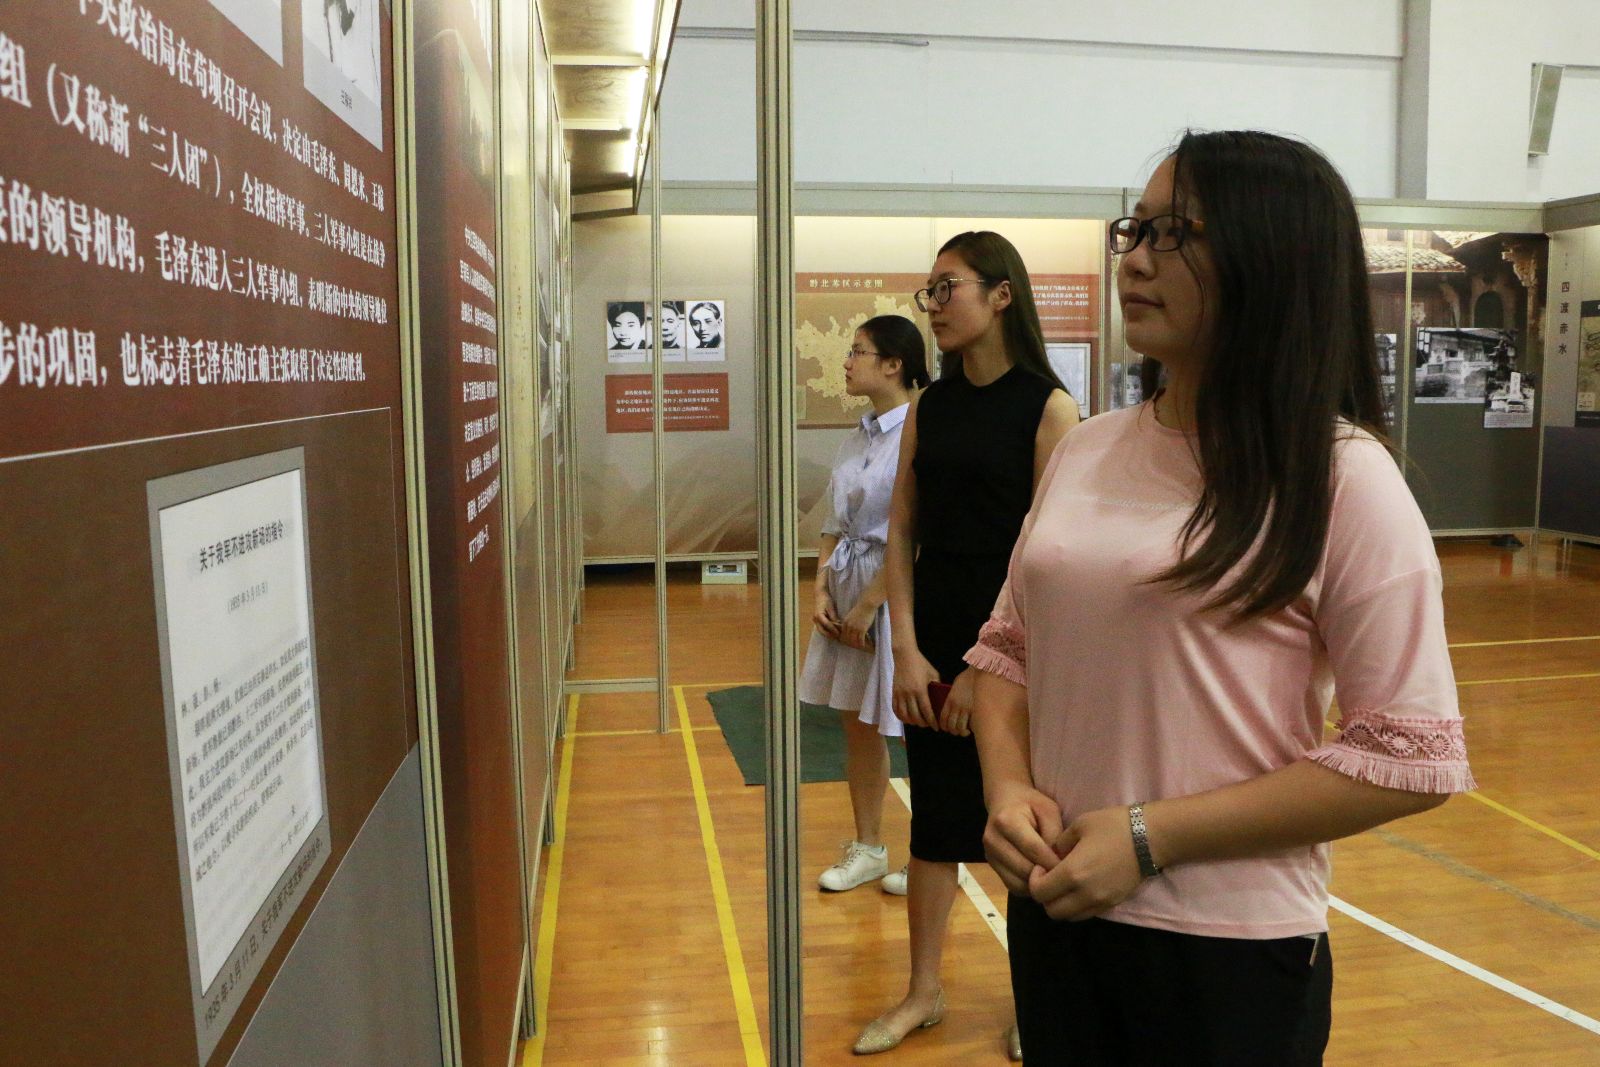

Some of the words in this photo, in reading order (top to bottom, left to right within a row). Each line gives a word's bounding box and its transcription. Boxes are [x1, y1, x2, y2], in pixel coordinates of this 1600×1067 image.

[79, 0, 385, 232] 央政治局在苟坝召开会议，决定由毛泽东、周恩来、王稼
[1558, 281, 1570, 355] 四渡赤水
[199, 519, 284, 573] 关于我军不进攻新场的指令
